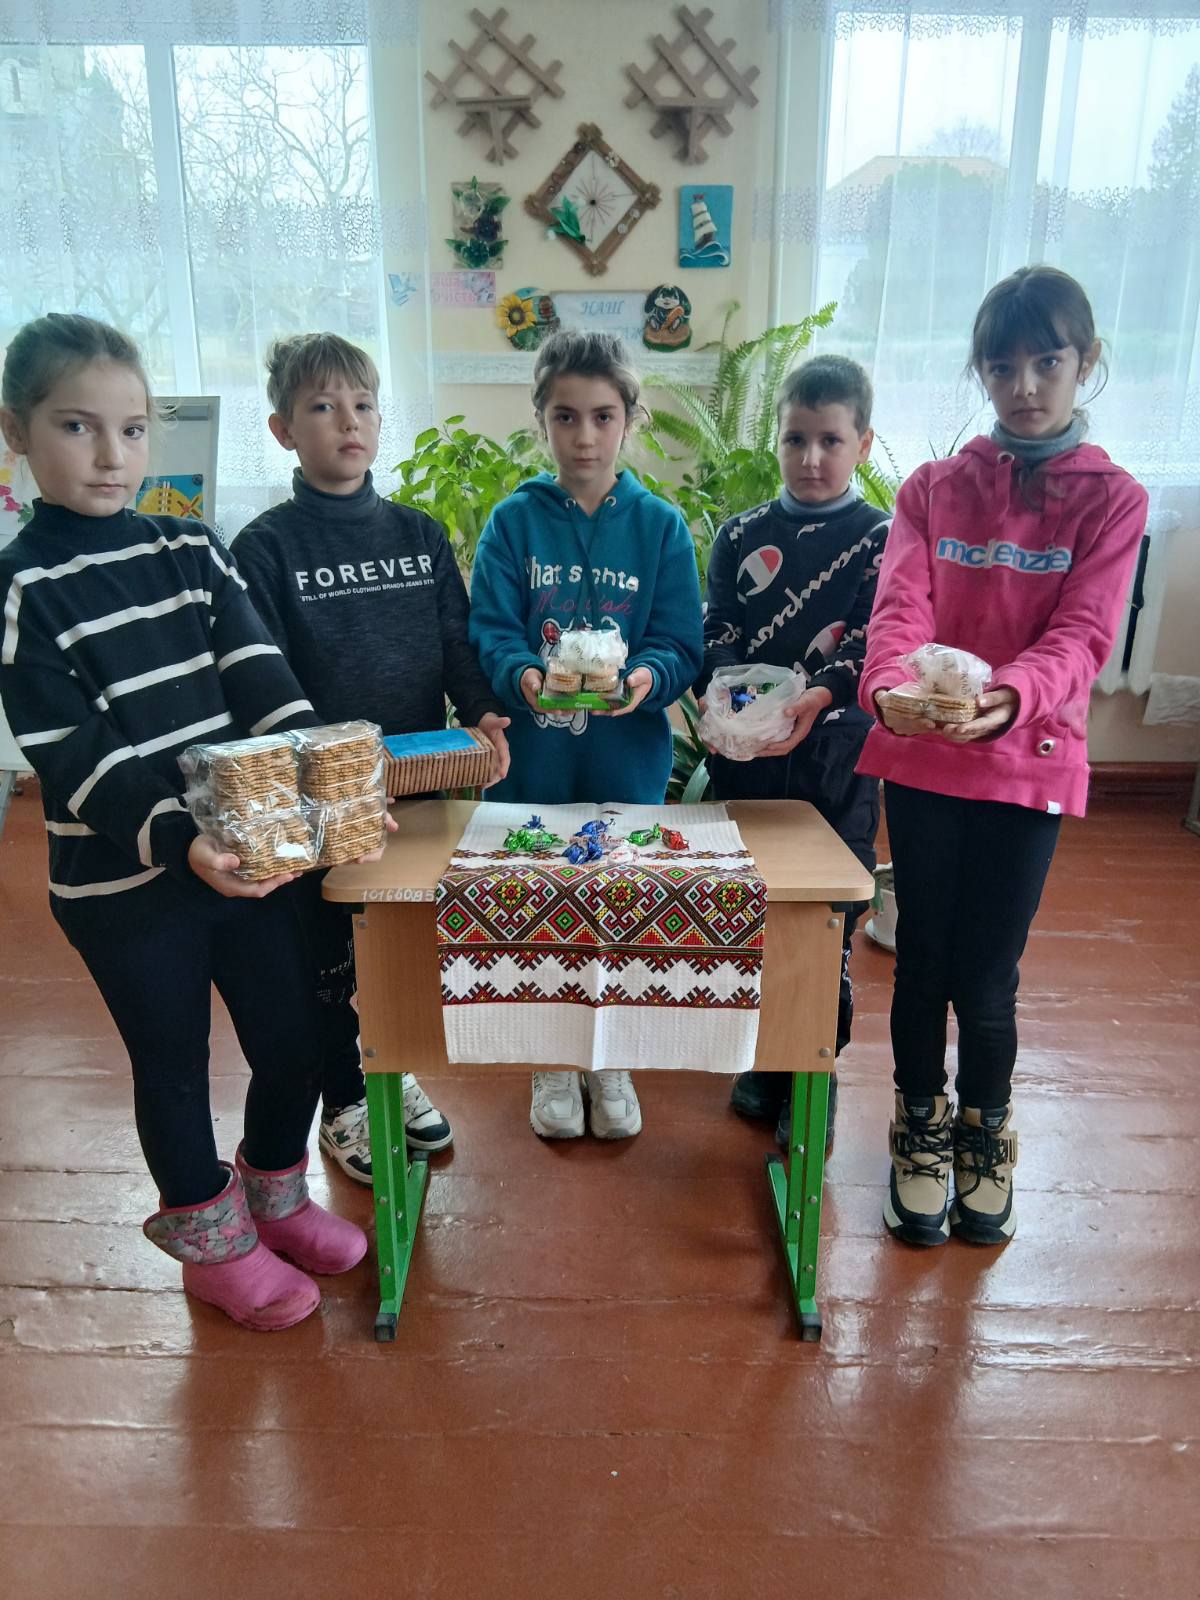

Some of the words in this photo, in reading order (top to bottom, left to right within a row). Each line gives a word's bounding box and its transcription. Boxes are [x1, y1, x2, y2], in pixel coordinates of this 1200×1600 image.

[295, 554, 433, 591] FOREVER
[936, 537, 1073, 575] mcenzie
[319, 592, 327, 600] OF
[328, 588, 351, 598] WORLD
[352, 585, 381, 594] CLOTHING
[382, 582, 405, 590] BRANDS
[405, 580, 422, 588] JEANS
